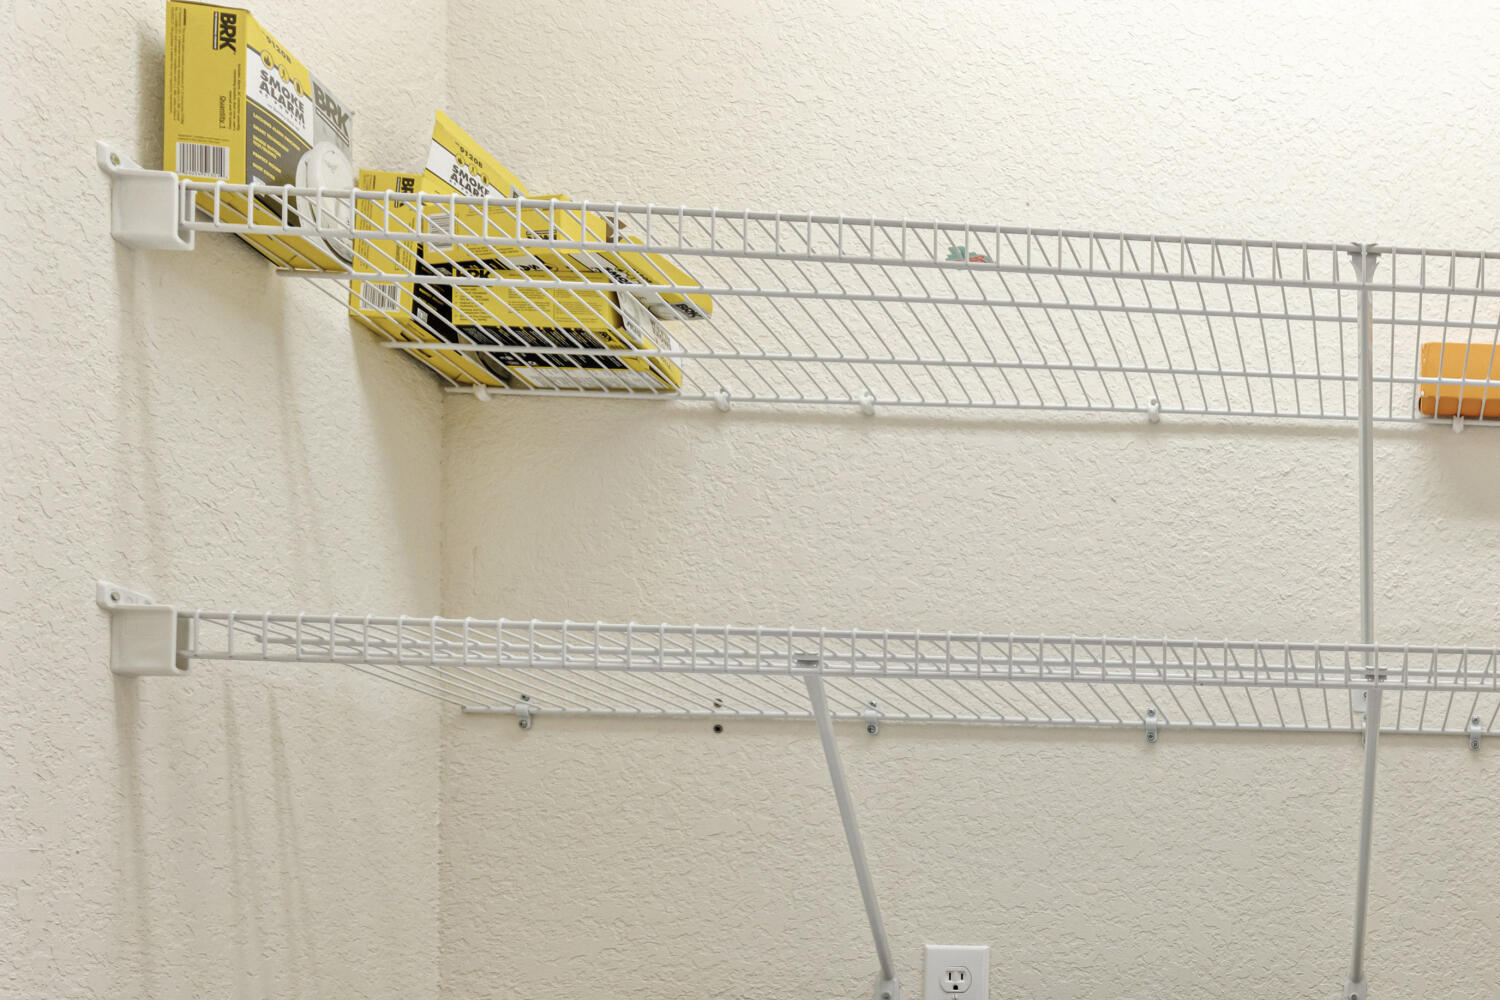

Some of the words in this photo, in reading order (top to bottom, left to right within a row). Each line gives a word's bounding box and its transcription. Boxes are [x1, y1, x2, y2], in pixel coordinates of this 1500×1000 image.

[220, 12, 237, 51] BRK
[259, 81, 305, 124] ALARM
[260, 69, 305, 113] SMOKE
[313, 81, 350, 138] BRK
